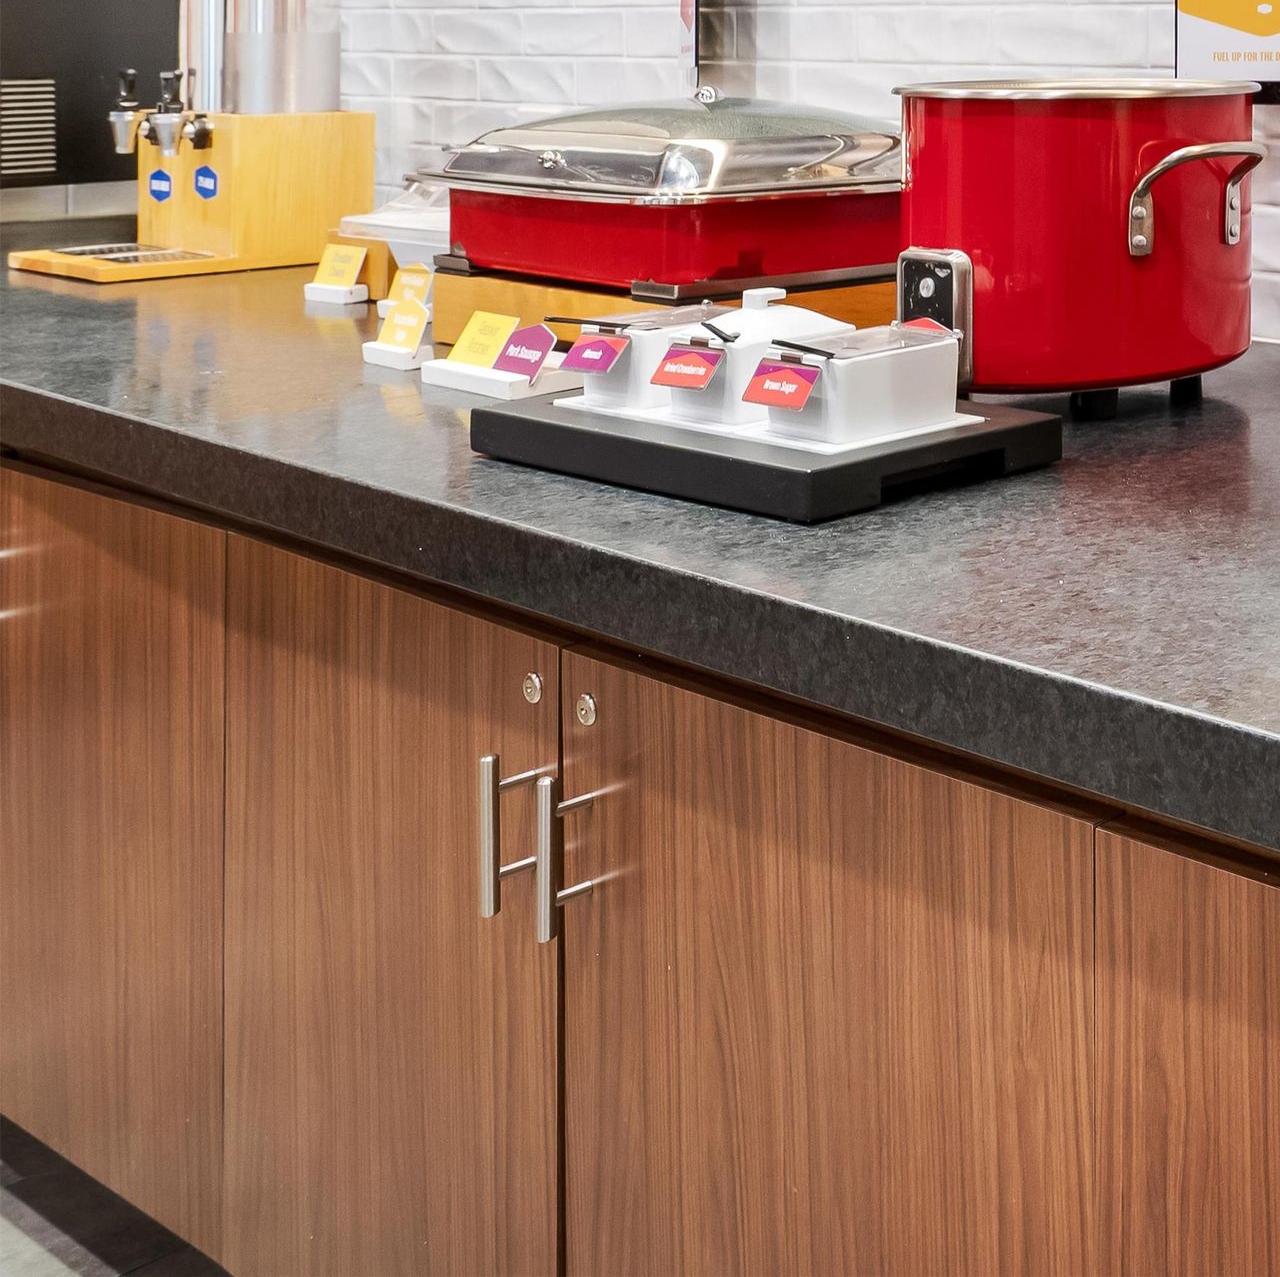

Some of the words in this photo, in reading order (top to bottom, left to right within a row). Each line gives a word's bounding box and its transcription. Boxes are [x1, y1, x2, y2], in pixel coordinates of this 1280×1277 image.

[1213, 51, 1230, 62] FUEL
[1231, 51, 1242, 62] UP
[1243, 51, 1258, 62] FOR
[1260, 51, 1274, 62] THE
